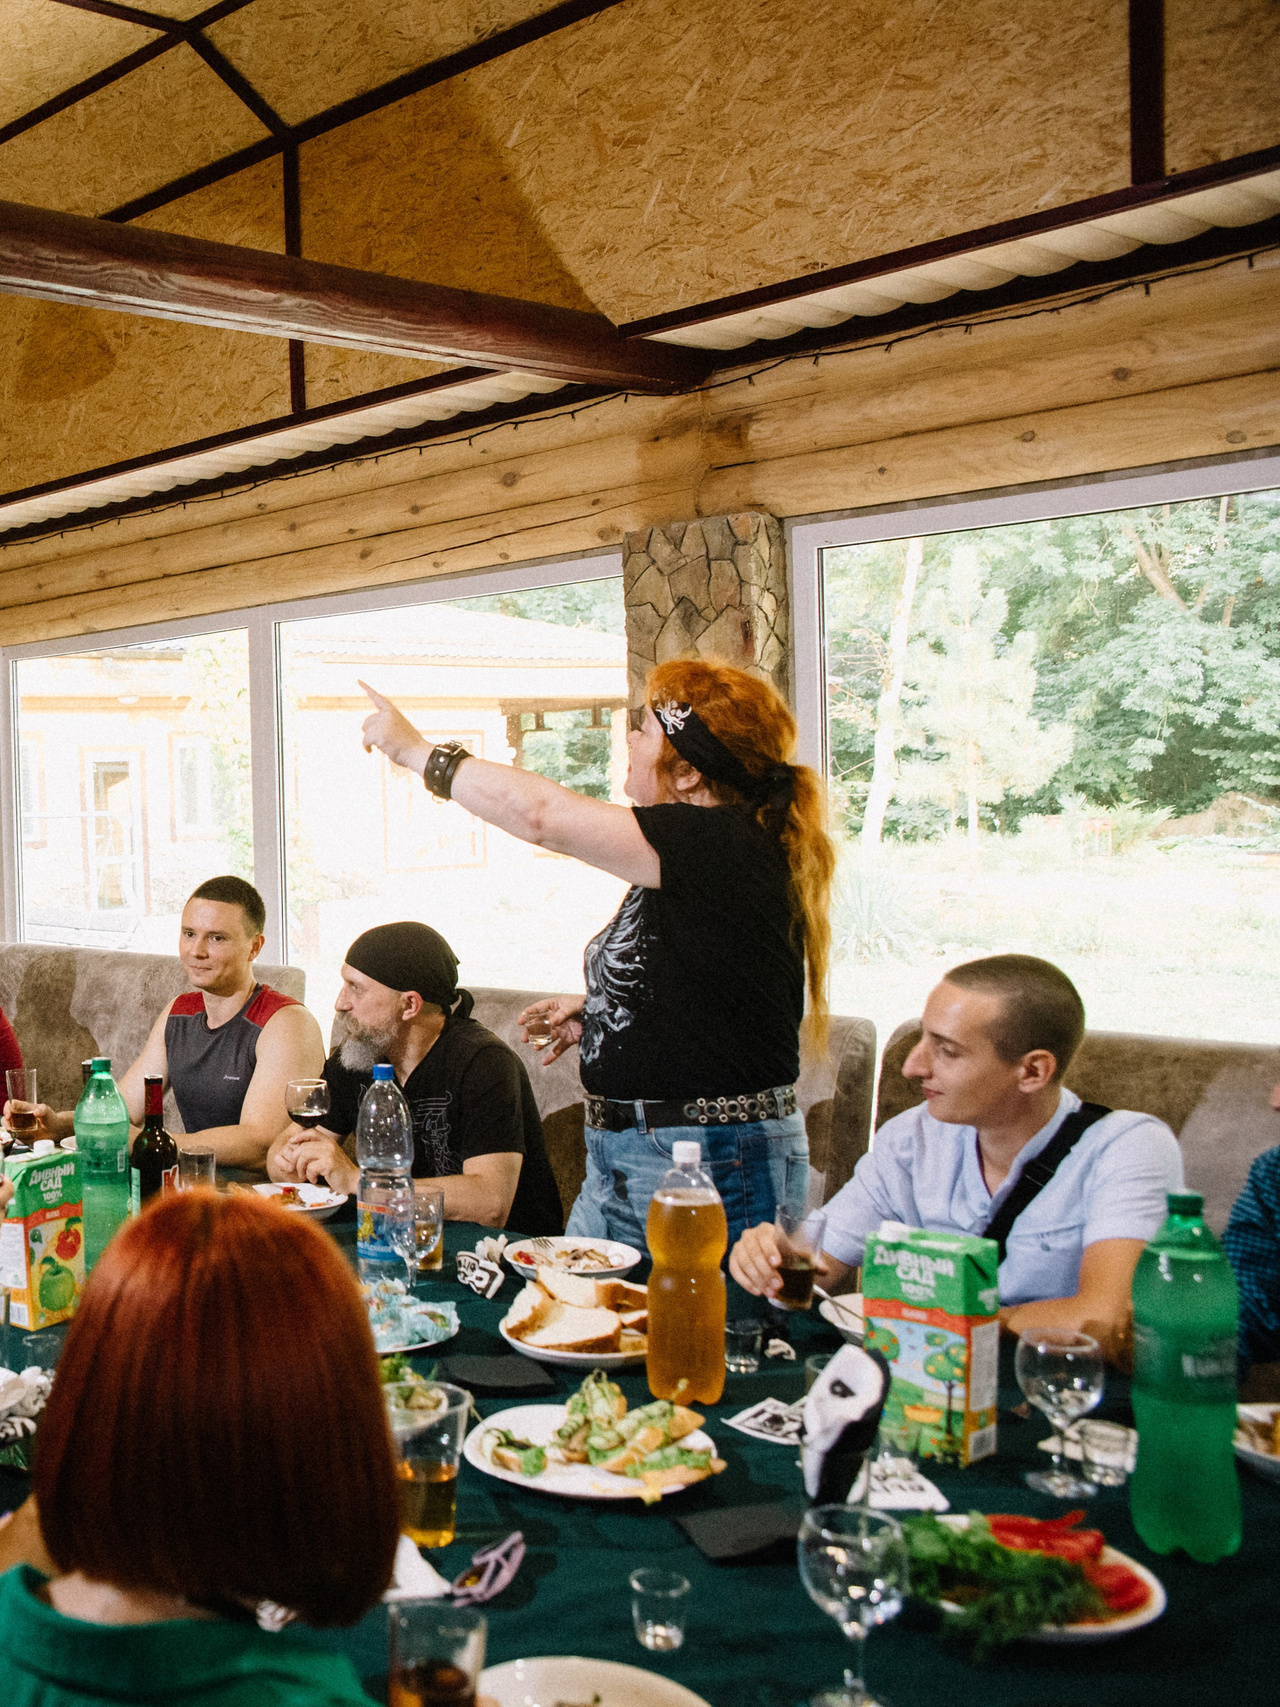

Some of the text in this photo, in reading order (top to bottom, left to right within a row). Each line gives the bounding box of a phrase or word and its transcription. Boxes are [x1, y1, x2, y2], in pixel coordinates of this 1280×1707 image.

[40, 1177, 62, 1191] САД
[43, 1191, 63, 1201] 100%
[896, 1262, 936, 1287] САД
